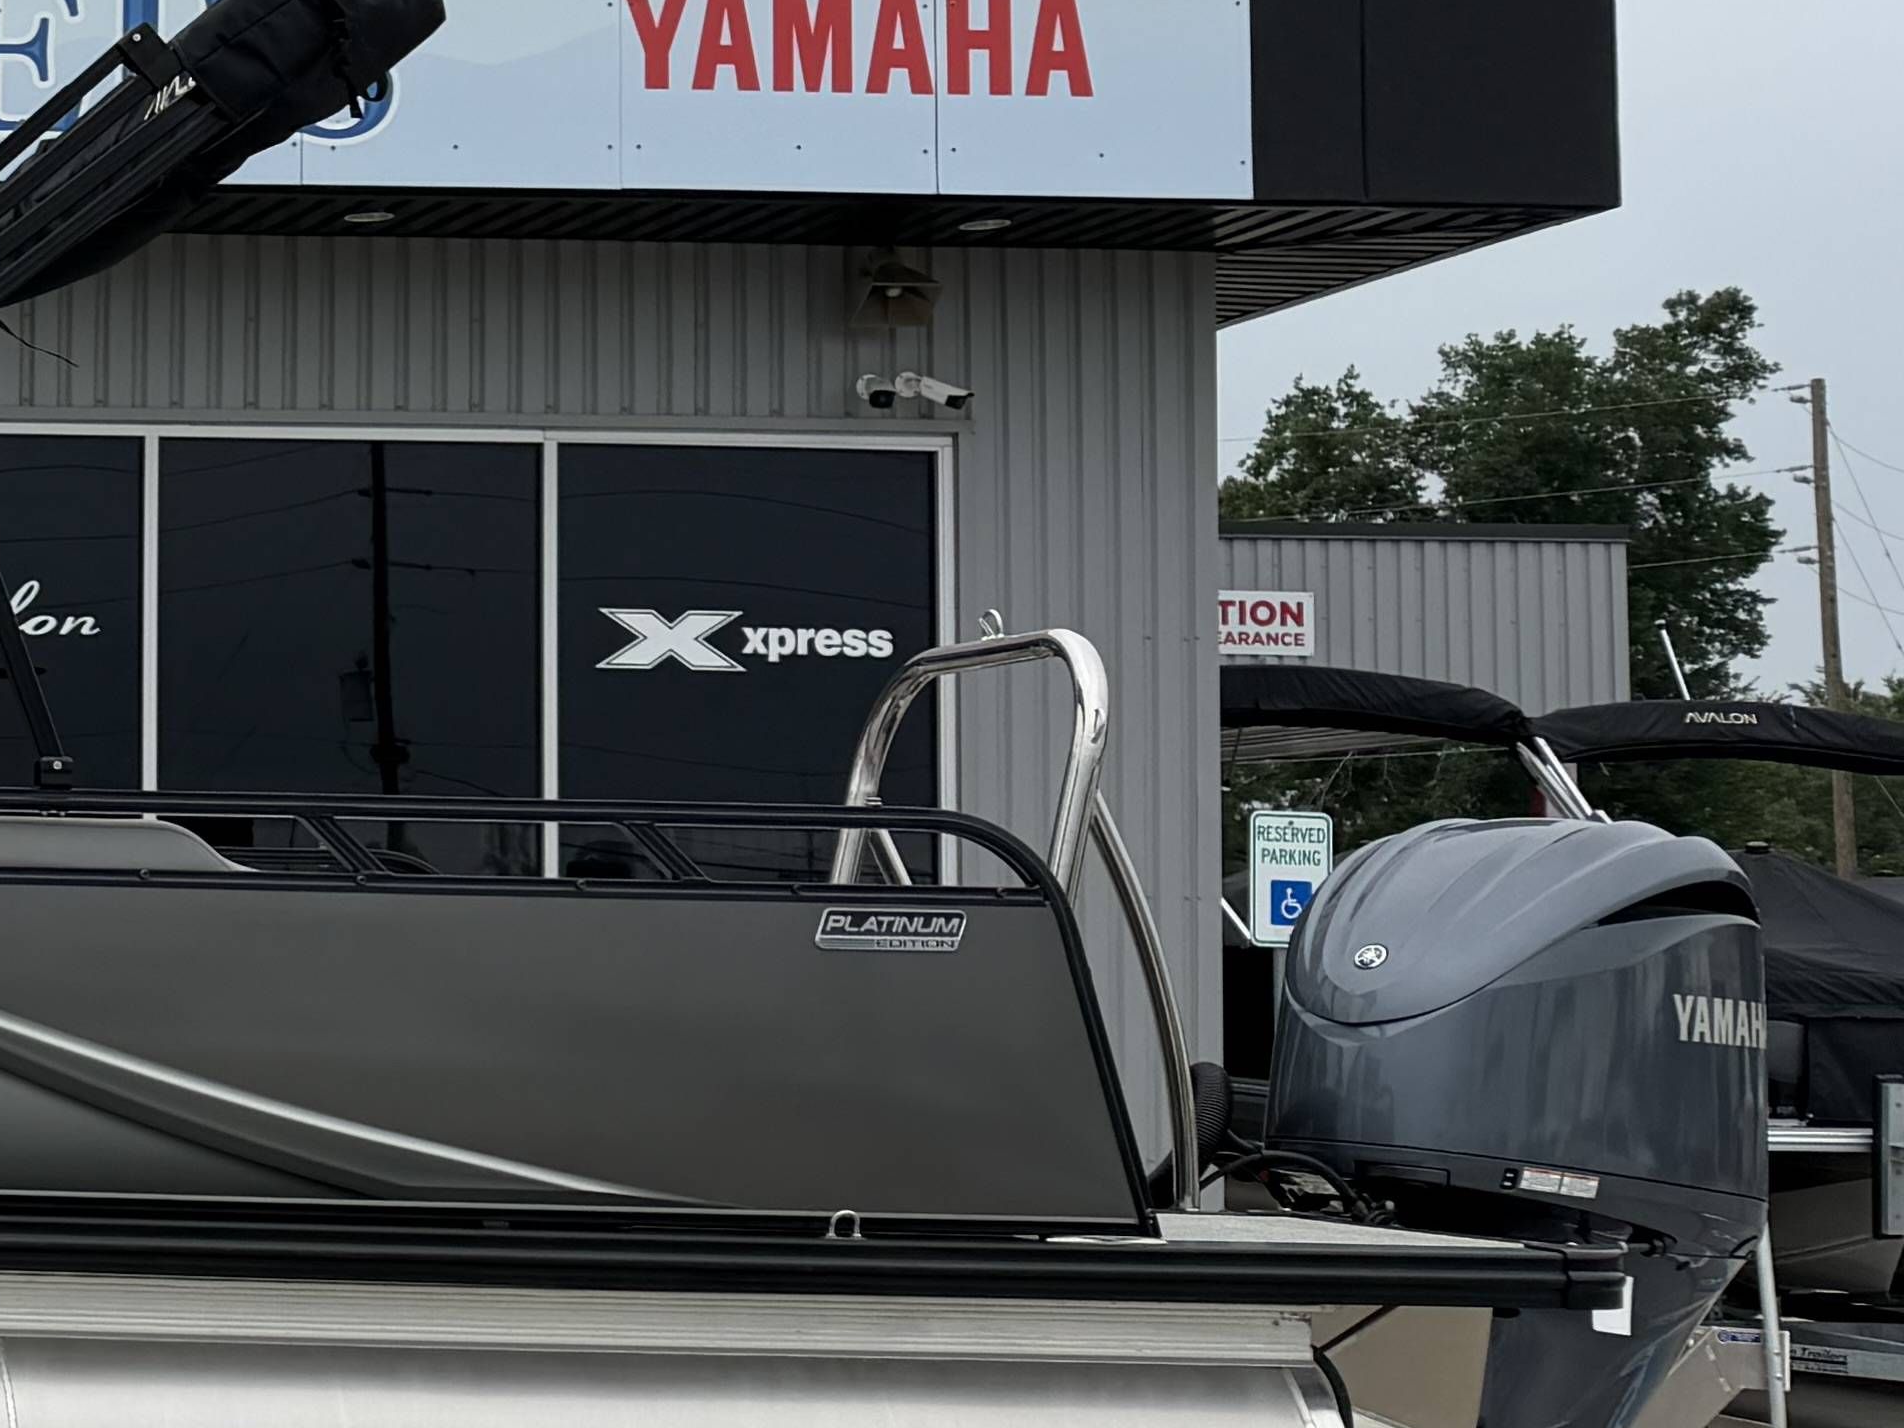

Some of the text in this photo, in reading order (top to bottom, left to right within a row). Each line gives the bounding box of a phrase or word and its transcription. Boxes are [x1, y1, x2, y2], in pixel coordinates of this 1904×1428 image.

[1219, 600, 1304, 627] TION
[742, 627, 893, 662] xpress
[1684, 712, 1758, 724] AVALON
[1257, 825, 1326, 843] RESERVED
[1261, 848, 1321, 866] PARKING
[825, 915, 961, 934] PLATINUM
[876, 939, 955, 949] EDITION
